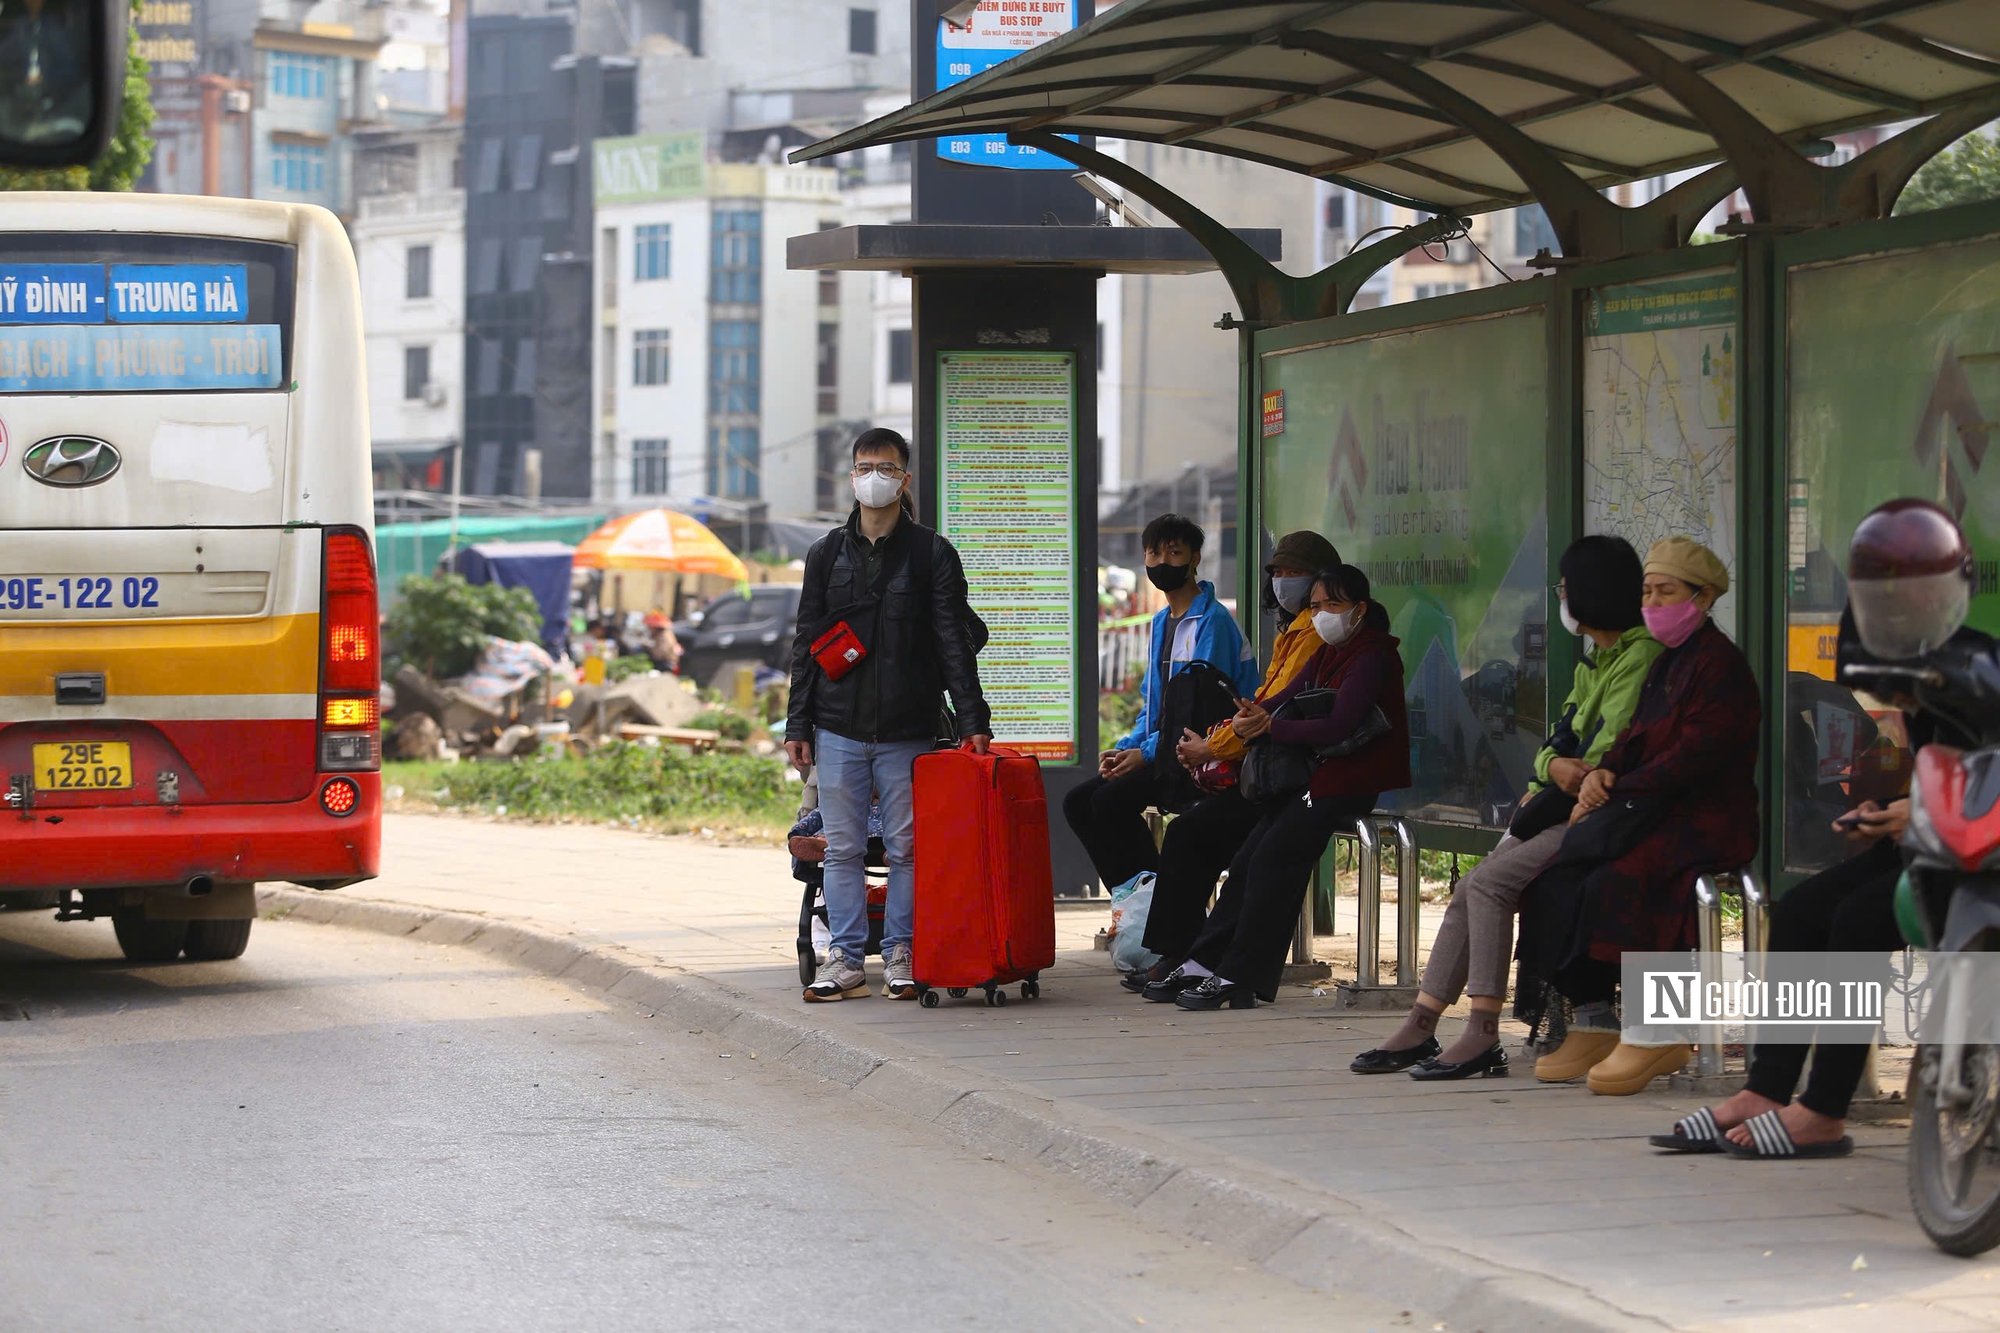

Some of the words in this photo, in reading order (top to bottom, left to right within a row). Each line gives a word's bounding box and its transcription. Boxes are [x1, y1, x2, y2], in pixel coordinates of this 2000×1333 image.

[1029, 2, 1040, 13] XE
[1043, 1, 1065, 13] BUÝT
[1000, 16, 1018, 26] BUS
[1021, 16, 1043, 26] STOP
[950, 63, 971, 76] 09B
[951, 141, 970, 154] E03
[985, 142, 1005, 154] E05
[0, 276, 18, 313] Ỹ
[26, 276, 87, 313] ĐÌNH
[115, 282, 197, 312] TRUNG
[205, 276, 238, 312] HÀ
[96, 331, 185, 377] PHÙNG
[1263, 394, 1277, 413] TAXI
[1374, 502, 1469, 541] advertising
[1401, 556, 1414, 586] CÁO
[123, 577, 159, 607] 02
[61, 744, 103, 764] 29E
[47, 766, 121, 787] 122.02
